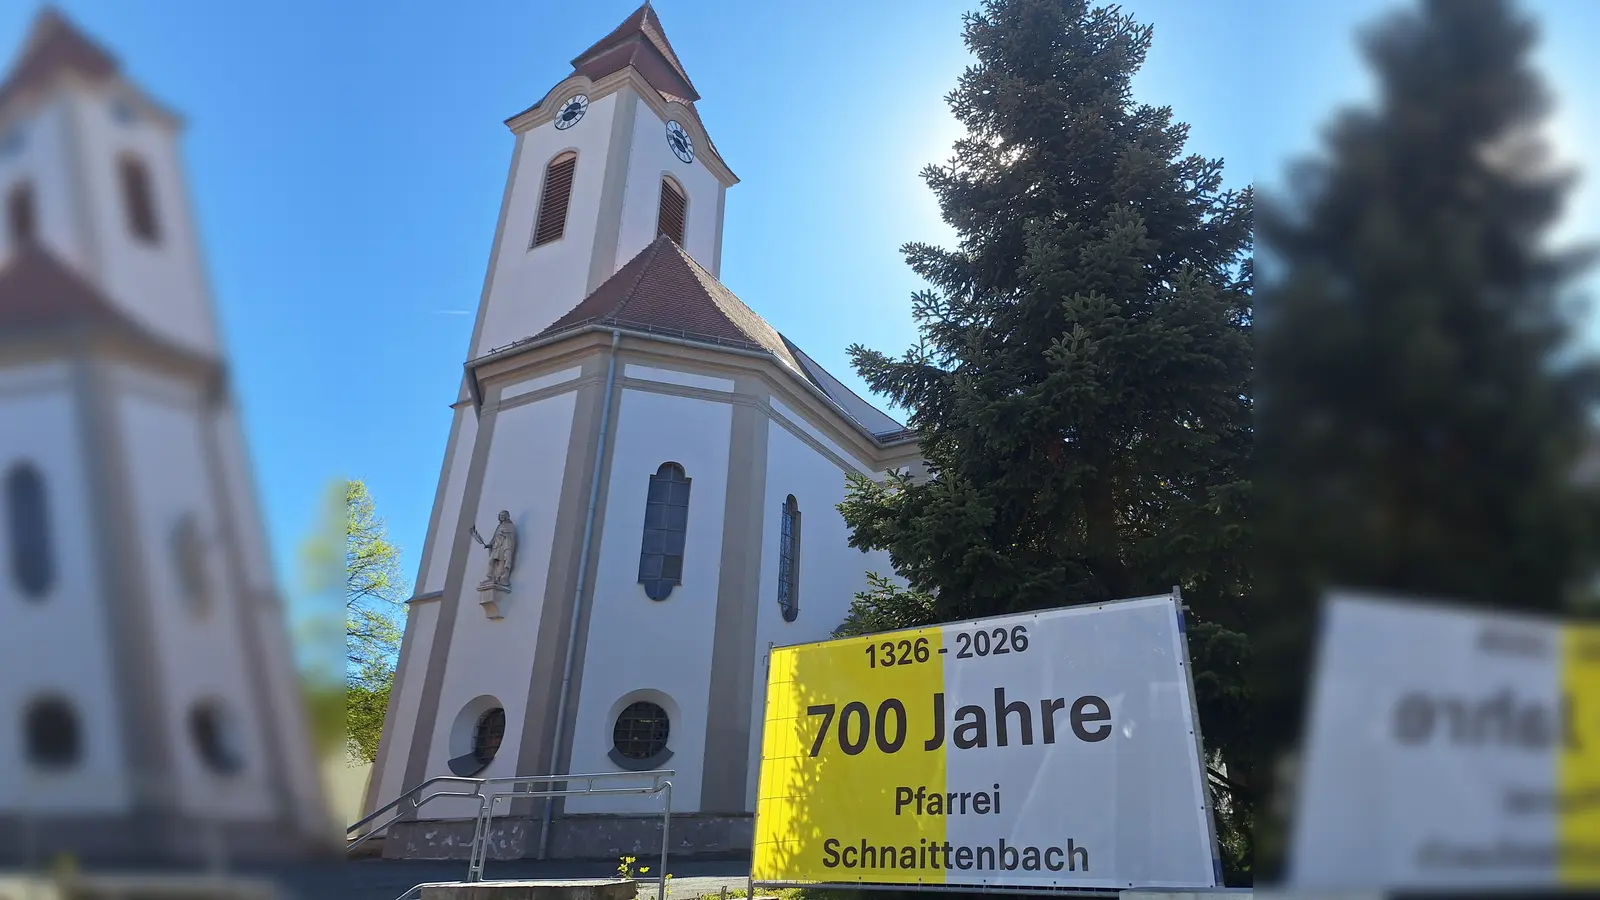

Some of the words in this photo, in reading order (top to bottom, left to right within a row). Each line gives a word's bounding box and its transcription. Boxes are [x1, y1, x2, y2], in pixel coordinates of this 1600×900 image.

[865, 637, 930, 669] 1326
[956, 625, 1029, 659] 2026
[806, 698, 907, 758] 700
[924, 687, 1112, 752] Jahre
[895, 783, 1001, 816] Pfarrei
[822, 838, 1089, 872] Schnaittenbach
